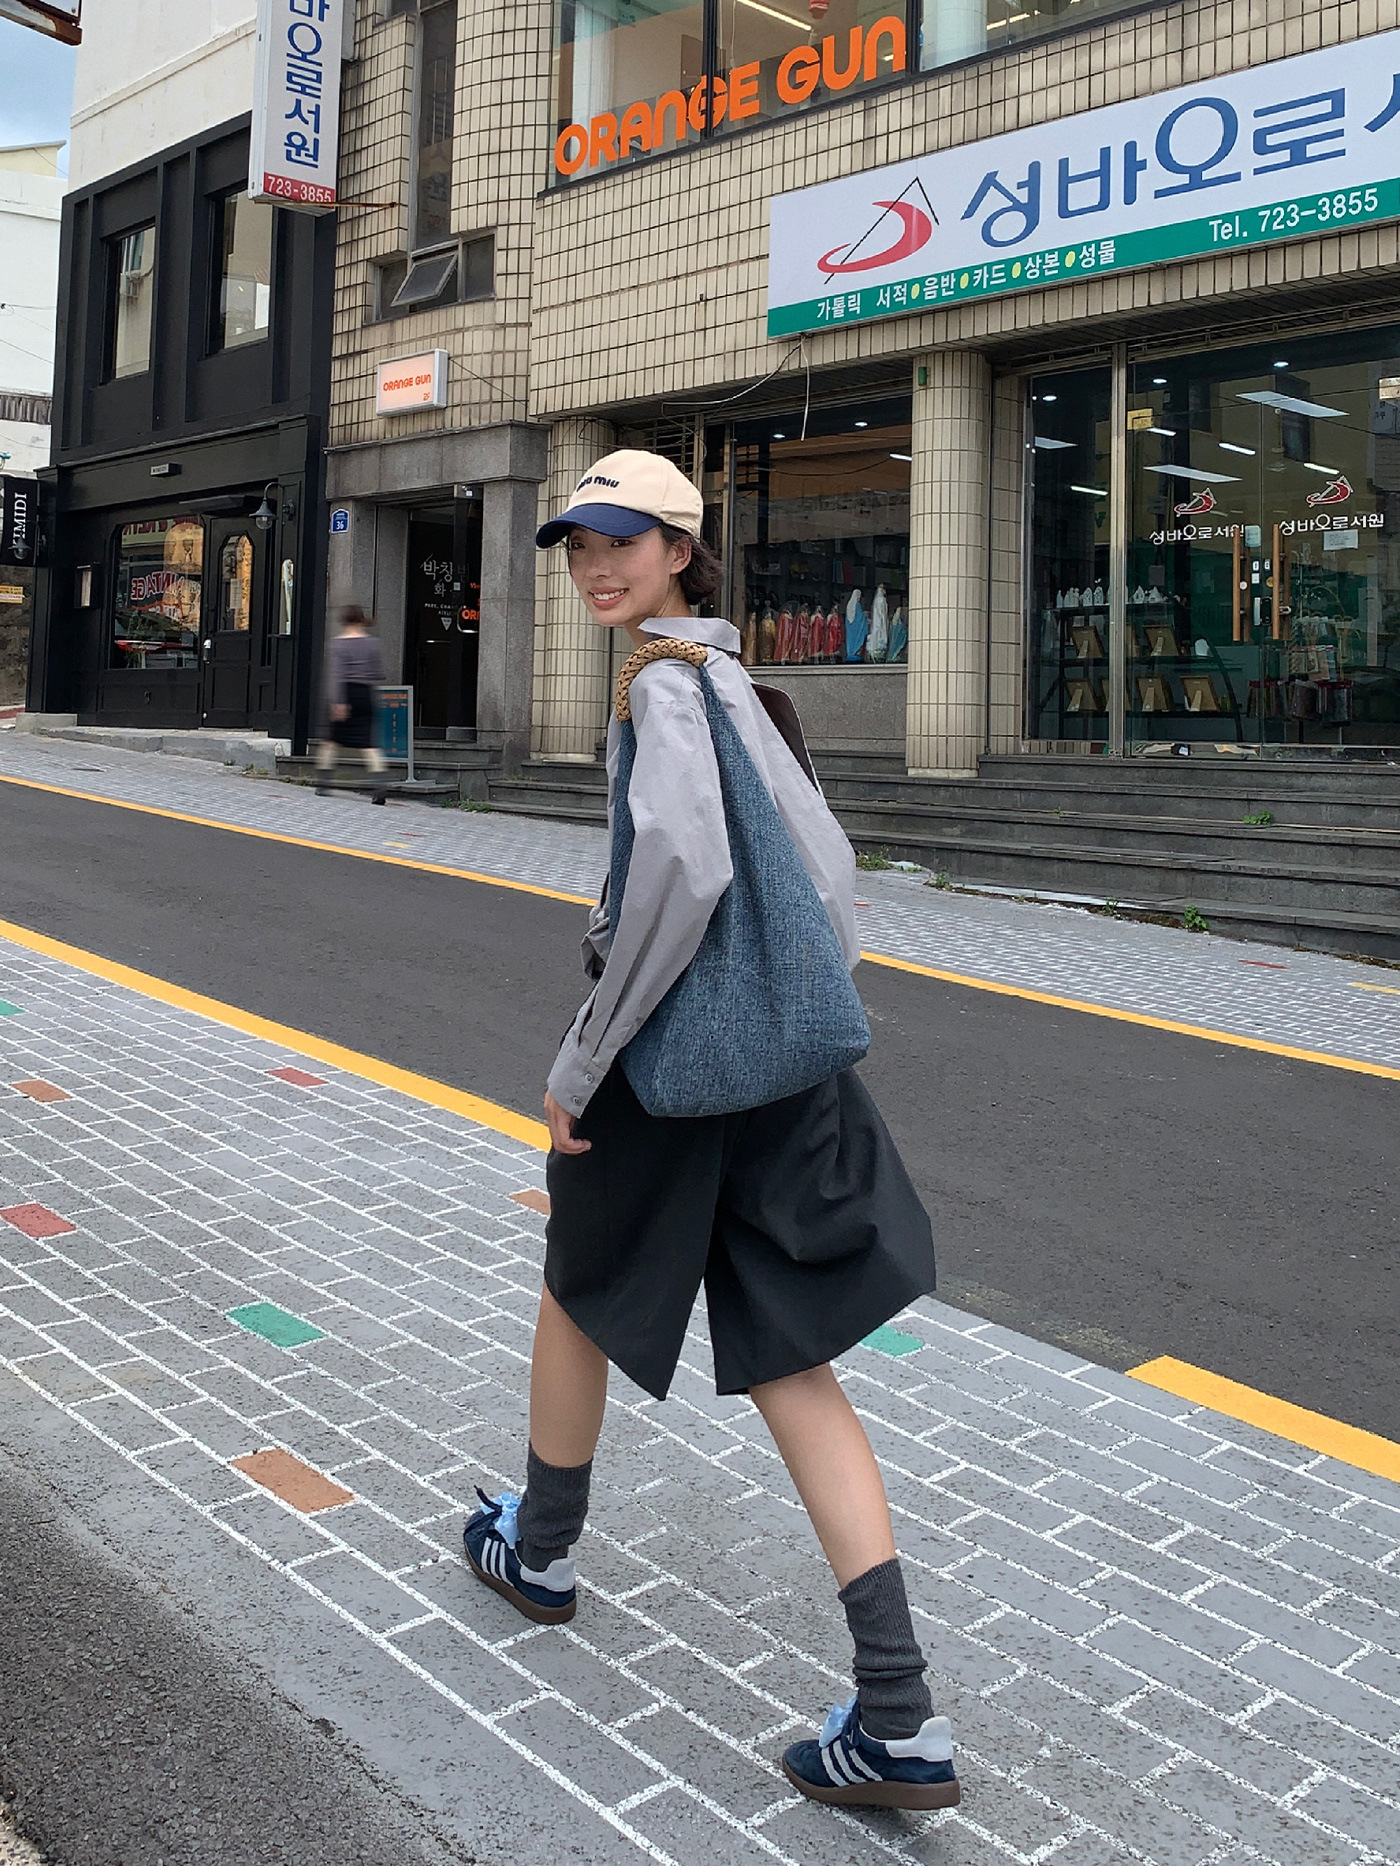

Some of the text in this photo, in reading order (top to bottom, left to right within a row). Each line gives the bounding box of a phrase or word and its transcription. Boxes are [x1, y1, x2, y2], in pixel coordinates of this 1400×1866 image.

[554, 15, 906, 176] ORANGE GUN
[960, 73, 1400, 248] 성바오로
[267, 176, 333, 202] 723-3855
[1208, 187, 1379, 243] Tel. 723-3855
[817, 240, 1117, 321] 가톨릭 서적 음반 카드 상본 성물
[383, 374, 431, 391] ORANGE GUN
[593, 475, 620, 488] miu
[336, 520, 345, 530] 36
[1279, 514, 1385, 536] 성바오로서원
